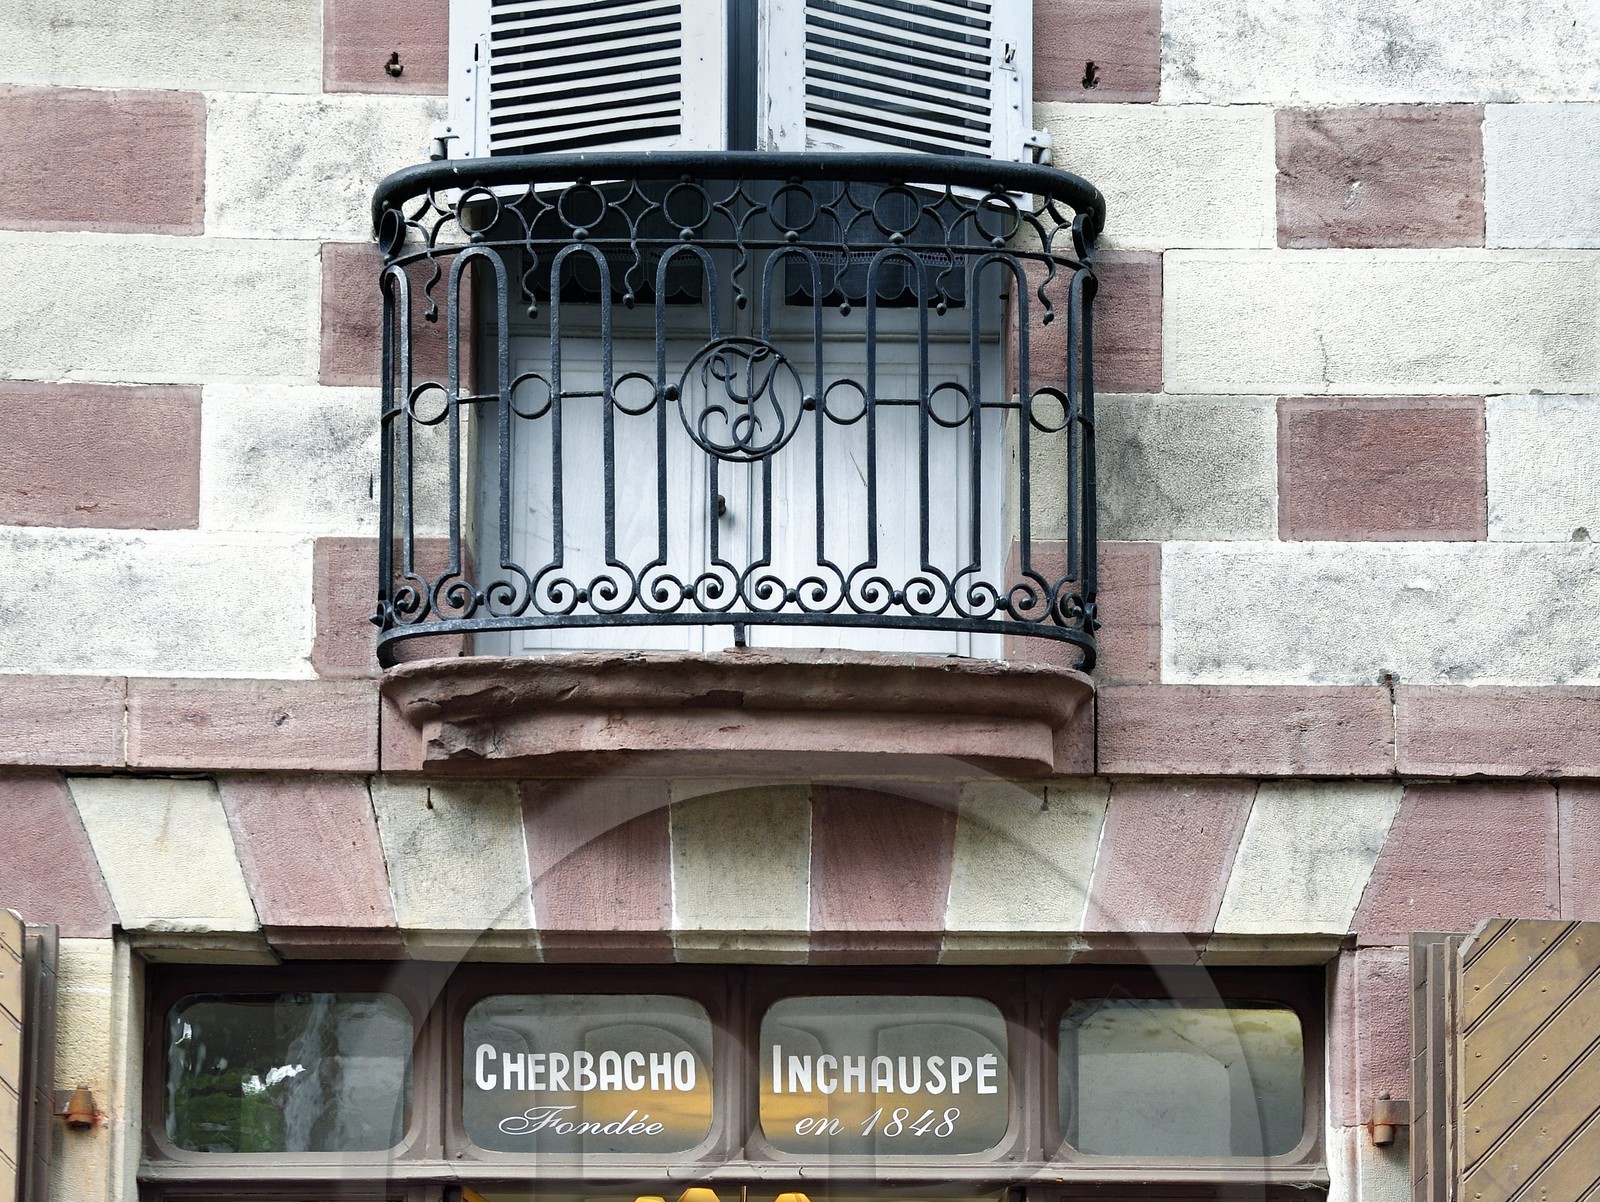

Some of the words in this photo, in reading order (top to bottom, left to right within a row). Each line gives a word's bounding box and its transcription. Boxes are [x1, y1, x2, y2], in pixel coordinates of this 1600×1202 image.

[475, 1043, 697, 1092] CHERBACHO
[772, 1044, 998, 1095] INCHAUSPÉ
[498, 1105, 665, 1136] Fondée
[795, 1117, 845, 1137] en
[860, 1107, 961, 1139] 1848
